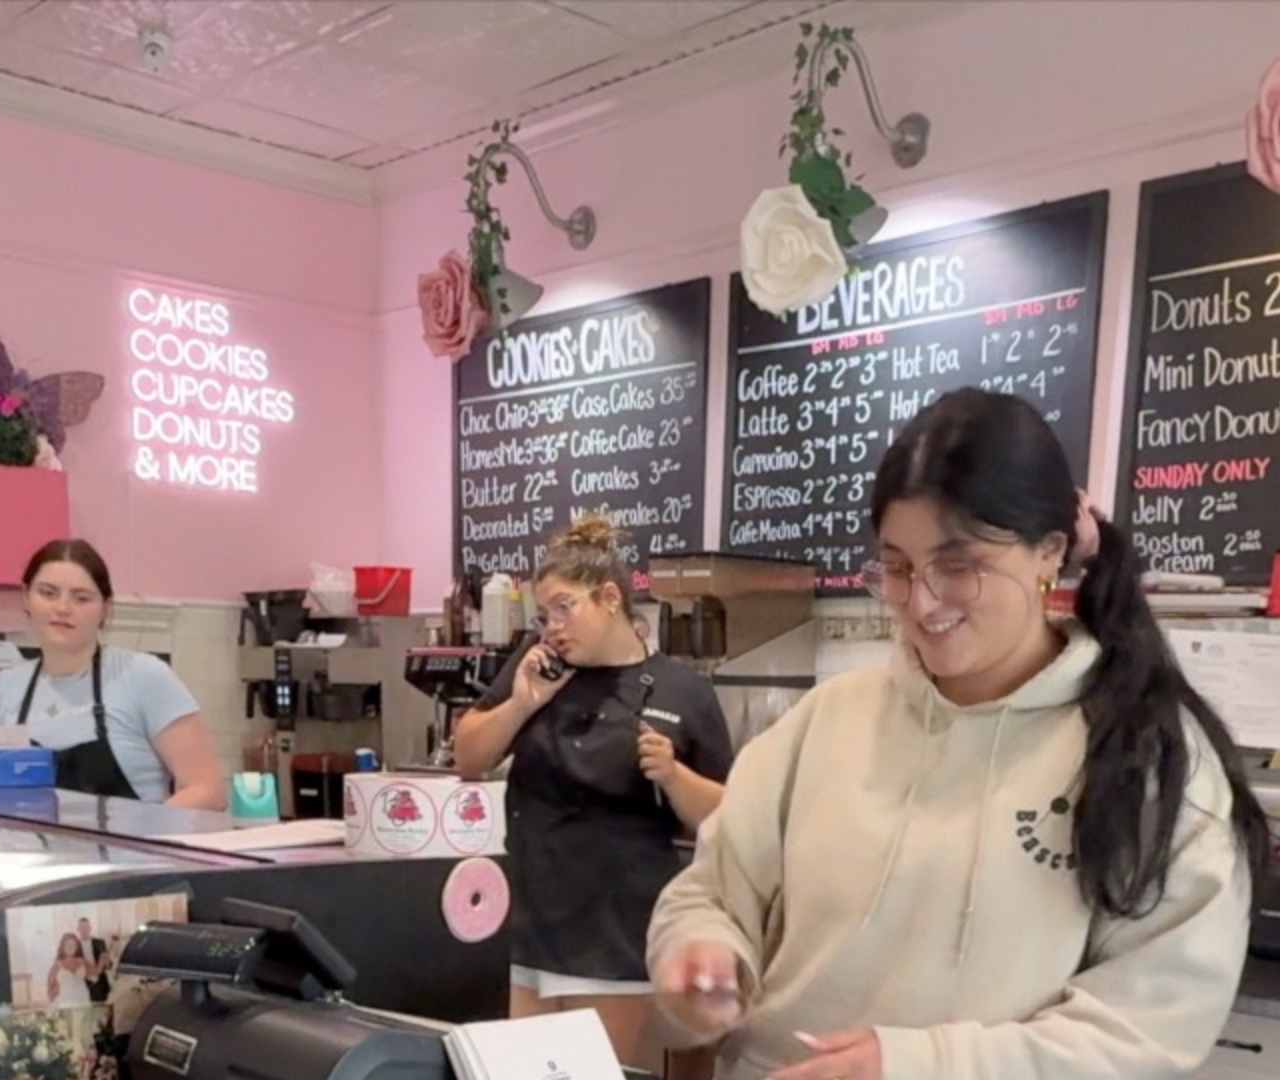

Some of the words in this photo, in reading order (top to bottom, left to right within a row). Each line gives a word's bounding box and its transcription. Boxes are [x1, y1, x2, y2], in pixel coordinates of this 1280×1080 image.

[129, 288, 230, 336] CAKES
[1151, 276, 1251, 334] Donuts
[129, 328, 269, 381] COOKIES
[580, 311, 655, 374] CAKES
[892, 345, 923, 381] Hot
[927, 343, 960, 375] Tea
[1144, 353, 1195, 393] Mini
[132, 369, 295, 423] CUPCAKES
[572, 387, 609, 419] Case
[609, 381, 654, 414] Cakes
[737, 364, 799, 402] Coffee
[461, 406, 493, 436] Choc
[738, 405, 790, 438] Latte
[889, 388, 921, 421] Hot
[132, 406, 262, 455] DONUTS
[570, 429, 618, 457] Coffee
[618, 424, 654, 451] Cake
[133, 445, 160, 480] &
[168, 450, 258, 493] MORE
[1134, 462, 1208, 489] SUNDAY
[1213, 457, 1270, 483] ONLY
[462, 476, 517, 508] Butter
[463, 513, 529, 541] Decorated
[730, 520, 760, 546] Cafe
[759, 520, 802, 542] Mocha
[1133, 532, 1204, 556] Boston
[1149, 553, 1214, 573] Cream
